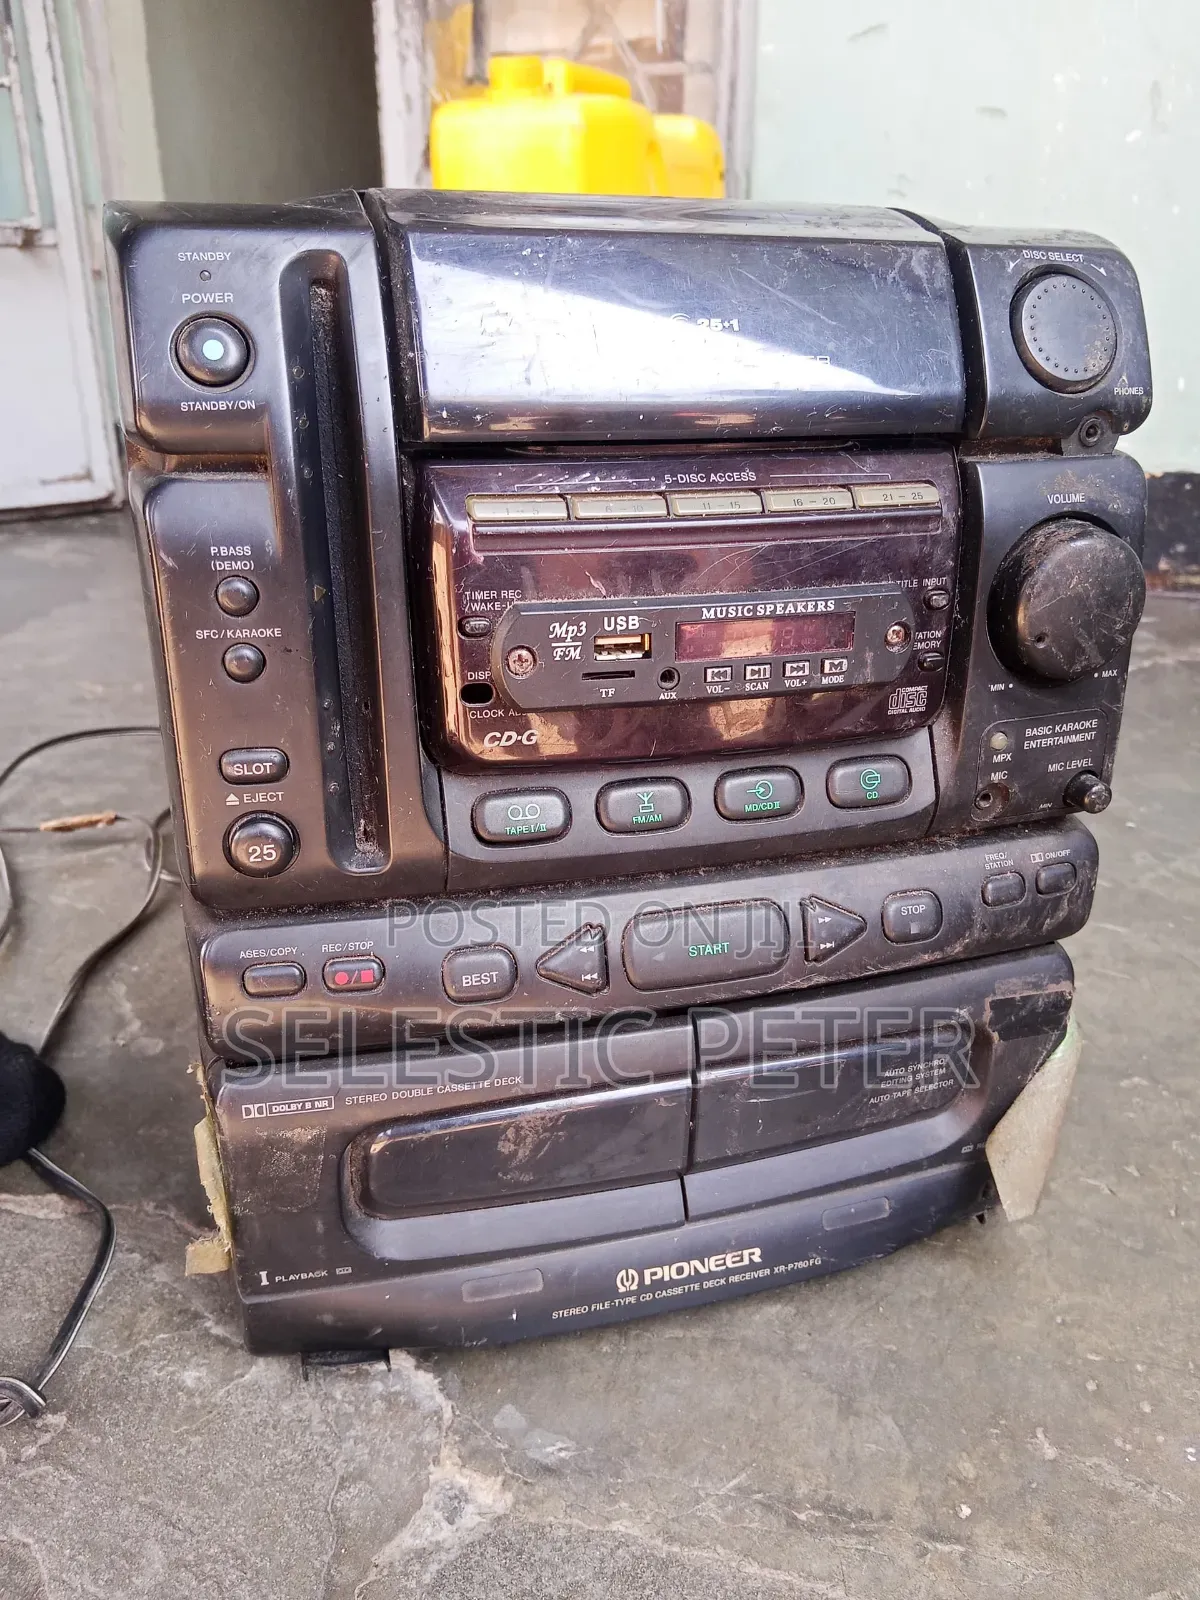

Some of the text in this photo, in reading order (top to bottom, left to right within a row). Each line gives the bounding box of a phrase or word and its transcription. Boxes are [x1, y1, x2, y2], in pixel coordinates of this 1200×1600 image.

[177, 251, 231, 262] STANDBY
[1022, 250, 1084, 263] DISC SELECT
[181, 292, 234, 304] POWER
[1114, 387, 1144, 396] PHONES
[180, 400, 256, 412] STANDBY/ON
[664, 471, 757, 484] 5-DISC ACCESS
[1047, 493, 1085, 504] VOLUME
[210, 545, 252, 557] P.BASS
[210, 560, 255, 571] (DEMO)
[923, 577, 947, 587] INPUT
[465, 590, 522, 600] TIMER REC
[701, 600, 835, 620] MUSIC SPEAKERS
[604, 616, 640, 631] USB
[915, 630, 942, 640] TATION
[913, 641, 941, 650] EMORY
[552, 646, 582, 661] FM
[467, 671, 492, 680] DISP
[1101, 669, 1117, 678] MAX
[745, 681, 769, 691] SCAN
[784, 678, 807, 688] VOL+
[821, 675, 844, 685] MODE
[600, 688, 615, 698] TF
[990, 683, 1004, 692] MIN
[659, 692, 677, 700] AUX
[470, 709, 504, 719] CLOCK
[1025, 719, 1098, 737] BASIC KARAOKE
[1024, 732, 1096, 749] ENTERTAINMENT
[993, 753, 1012, 763] MPX
[233, 762, 273, 776] SLOT
[1048, 758, 1093, 772] MIC LEVEL
[991, 771, 1008, 781] MIC
[243, 791, 285, 804] EJECT
[866, 791, 878, 800] CD
[633, 814, 662, 824] FM/AM
[248, 844, 277, 862] 25
[1045, 849, 1071, 859] ON/OFF
[985, 859, 1014, 870] STATION
[901, 904, 926, 916] STOP
[239, 946, 298, 959] ASES/COPY
[322, 940, 374, 953] REC/STOP
[689, 942, 729, 957] START
[462, 971, 499, 986] BEST
[884, 1058, 945, 1077] AUTO SYNCHRO
[881, 1067, 946, 1088] EDITING SYSTEM
[345, 1075, 523, 1107] STEREO DOUBLE CASSETTE DECK
[869, 1079, 954, 1104] AUTO TAPE SELECTOR
[272, 1099, 329, 1113] DOLBY B NR
[644, 1247, 763, 1285] PIONEER
[275, 1269, 329, 1283] PLAYBACK
[552, 1305, 589, 1320] STEREO
[591, 1295, 637, 1312] FILE-TYPE
[640, 1291, 653, 1302] CD
[655, 1283, 700, 1299] CASSETTE
[703, 1277, 727, 1290] DECK
[728, 1268, 770, 1284] RECEIVER
